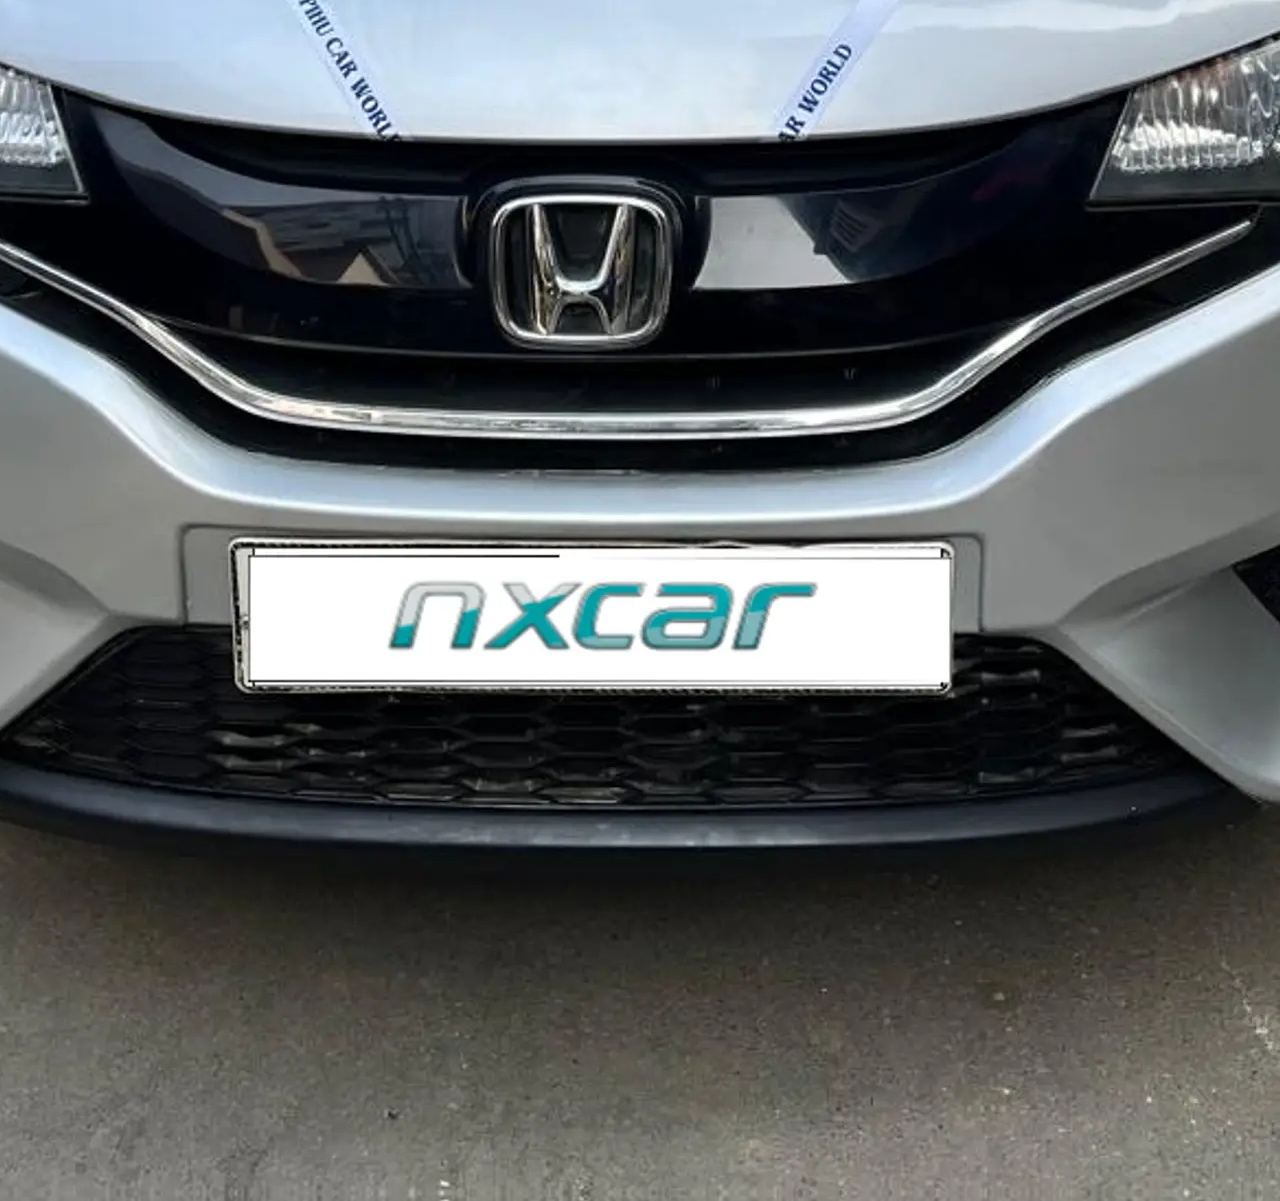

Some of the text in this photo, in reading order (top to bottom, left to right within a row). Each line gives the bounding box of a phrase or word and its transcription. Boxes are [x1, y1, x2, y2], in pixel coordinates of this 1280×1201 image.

[326, 37, 358, 79] CAR
[778, 44, 852, 142] AR WORLD
